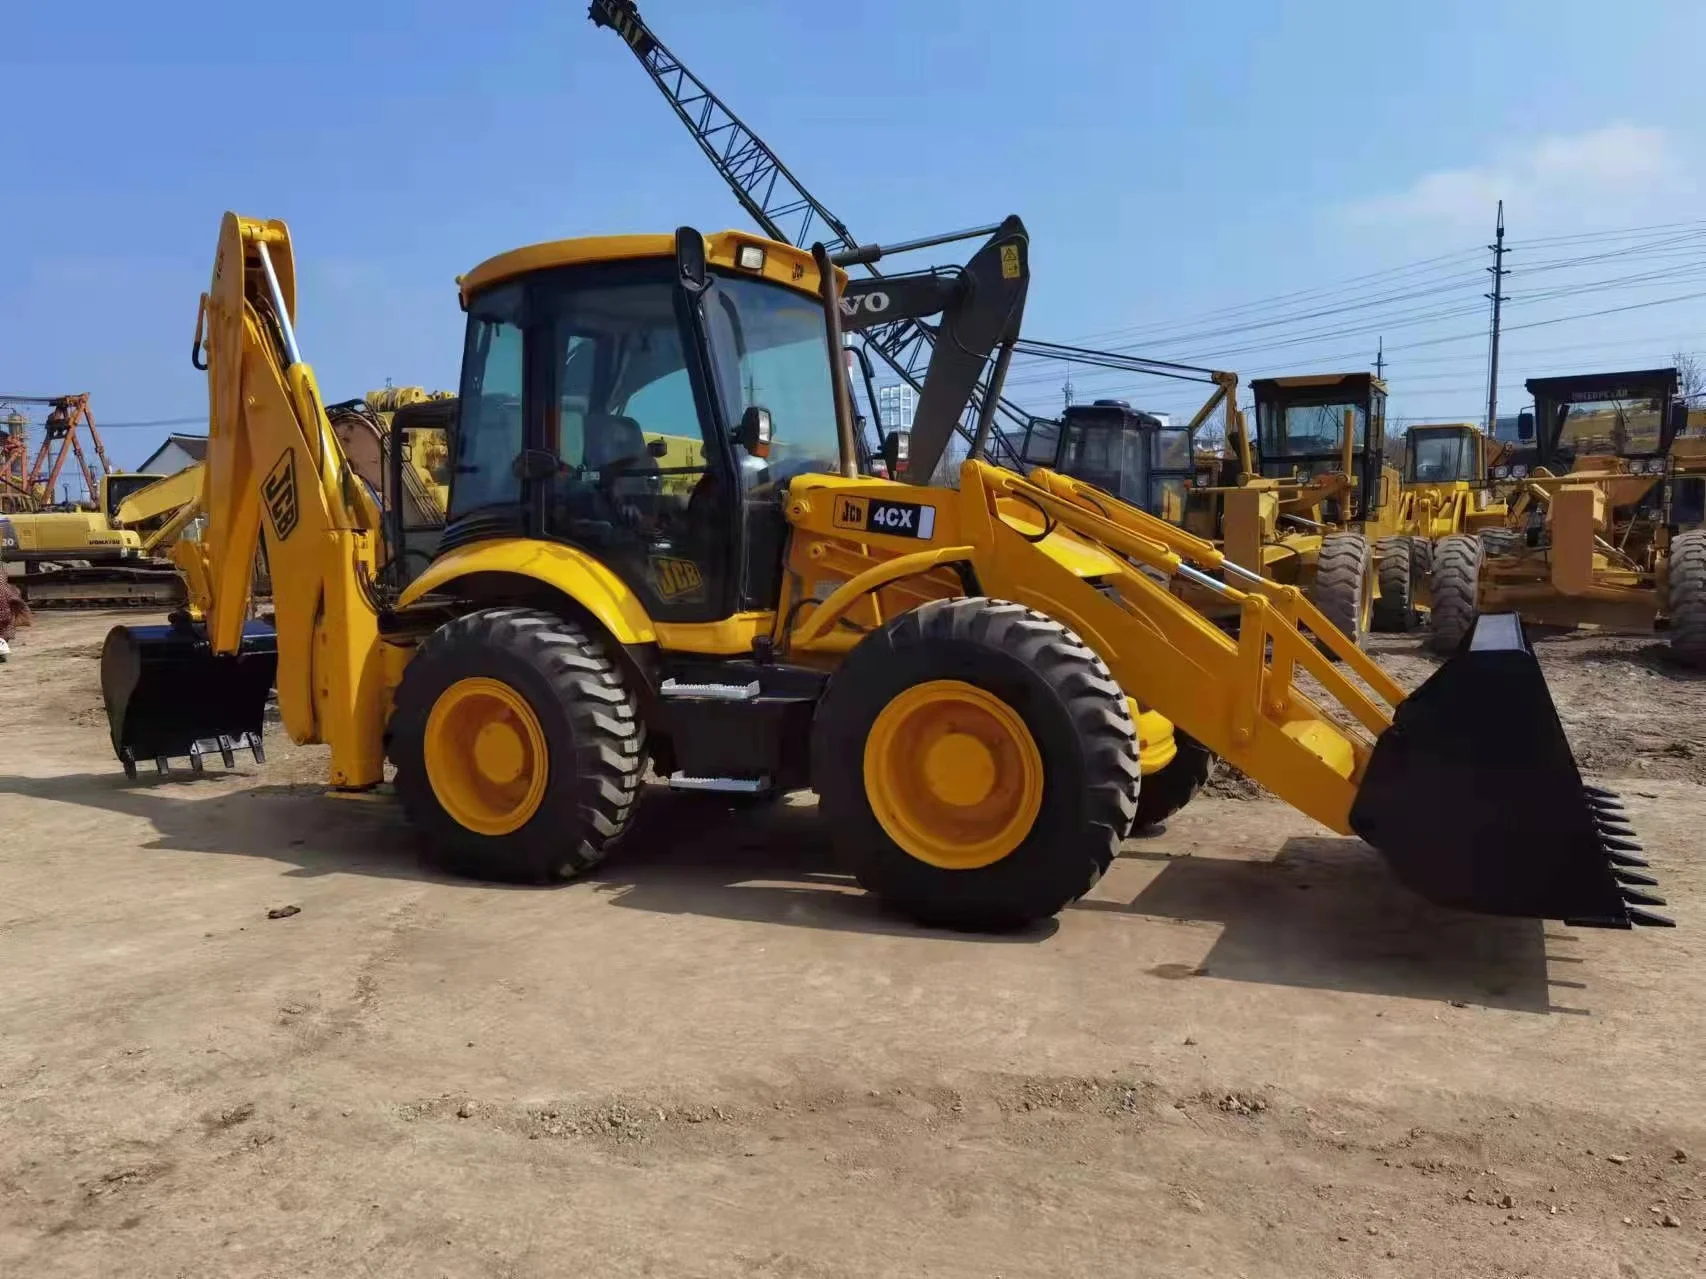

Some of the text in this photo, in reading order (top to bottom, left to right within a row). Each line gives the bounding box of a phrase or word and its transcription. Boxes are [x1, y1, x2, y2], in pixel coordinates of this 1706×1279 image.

[264, 462, 295, 536] JCB
[842, 501, 913, 528] JCB 4CX
[656, 560, 700, 594] JCB
